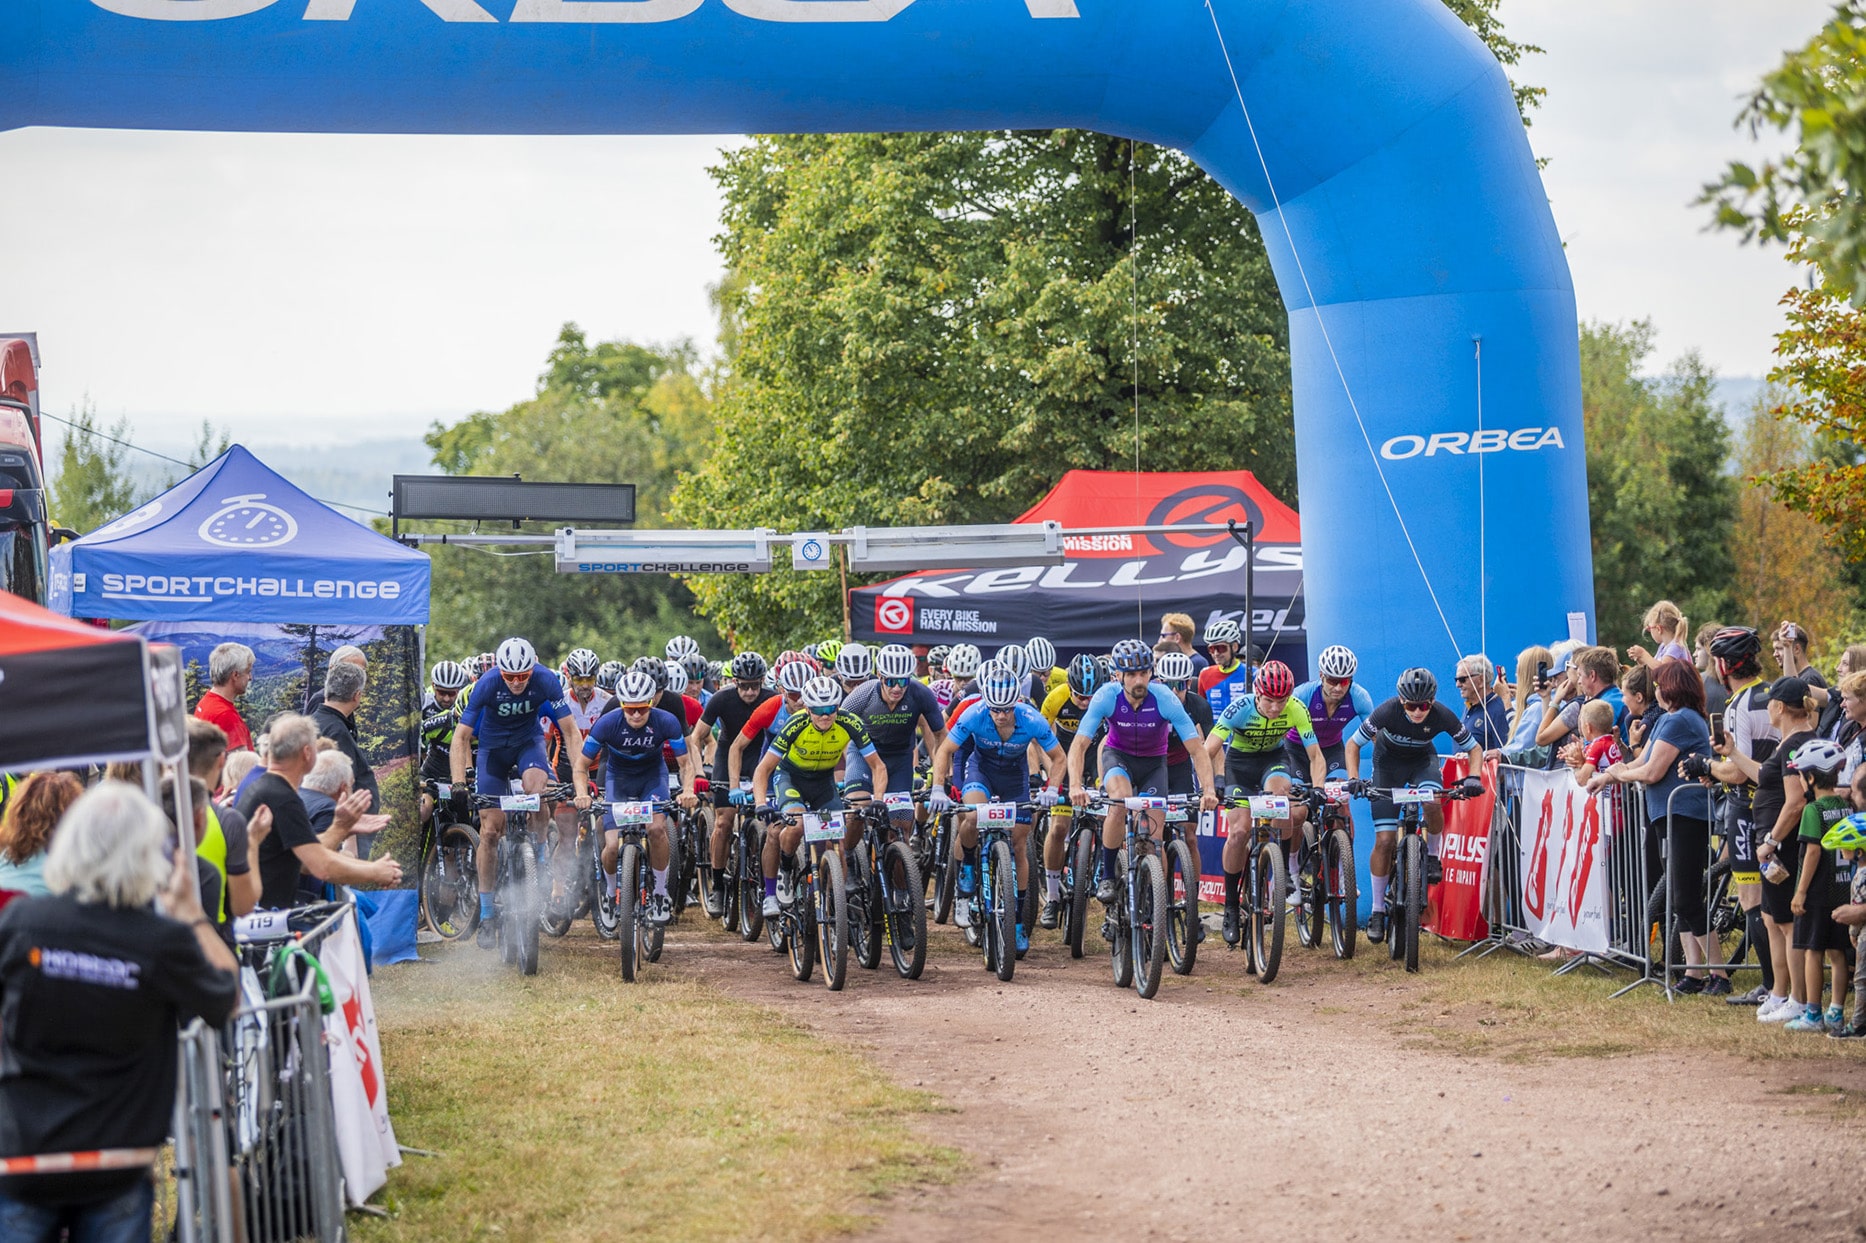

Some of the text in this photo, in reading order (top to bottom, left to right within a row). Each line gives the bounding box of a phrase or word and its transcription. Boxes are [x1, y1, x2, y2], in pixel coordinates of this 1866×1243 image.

[1380, 426, 1565, 461] ORBEA
[920, 608, 980, 621] EVERY BIKE
[920, 619, 997, 633] HAS A MISSION
[498, 700, 534, 717] SKL
[622, 736, 654, 747] KAH
[1141, 800, 1150, 809] 3
[1265, 801, 1275, 809] 5
[988, 808, 1005, 820] 63
[820, 821, 829, 830] 2
[249, 916, 273, 930] 119
